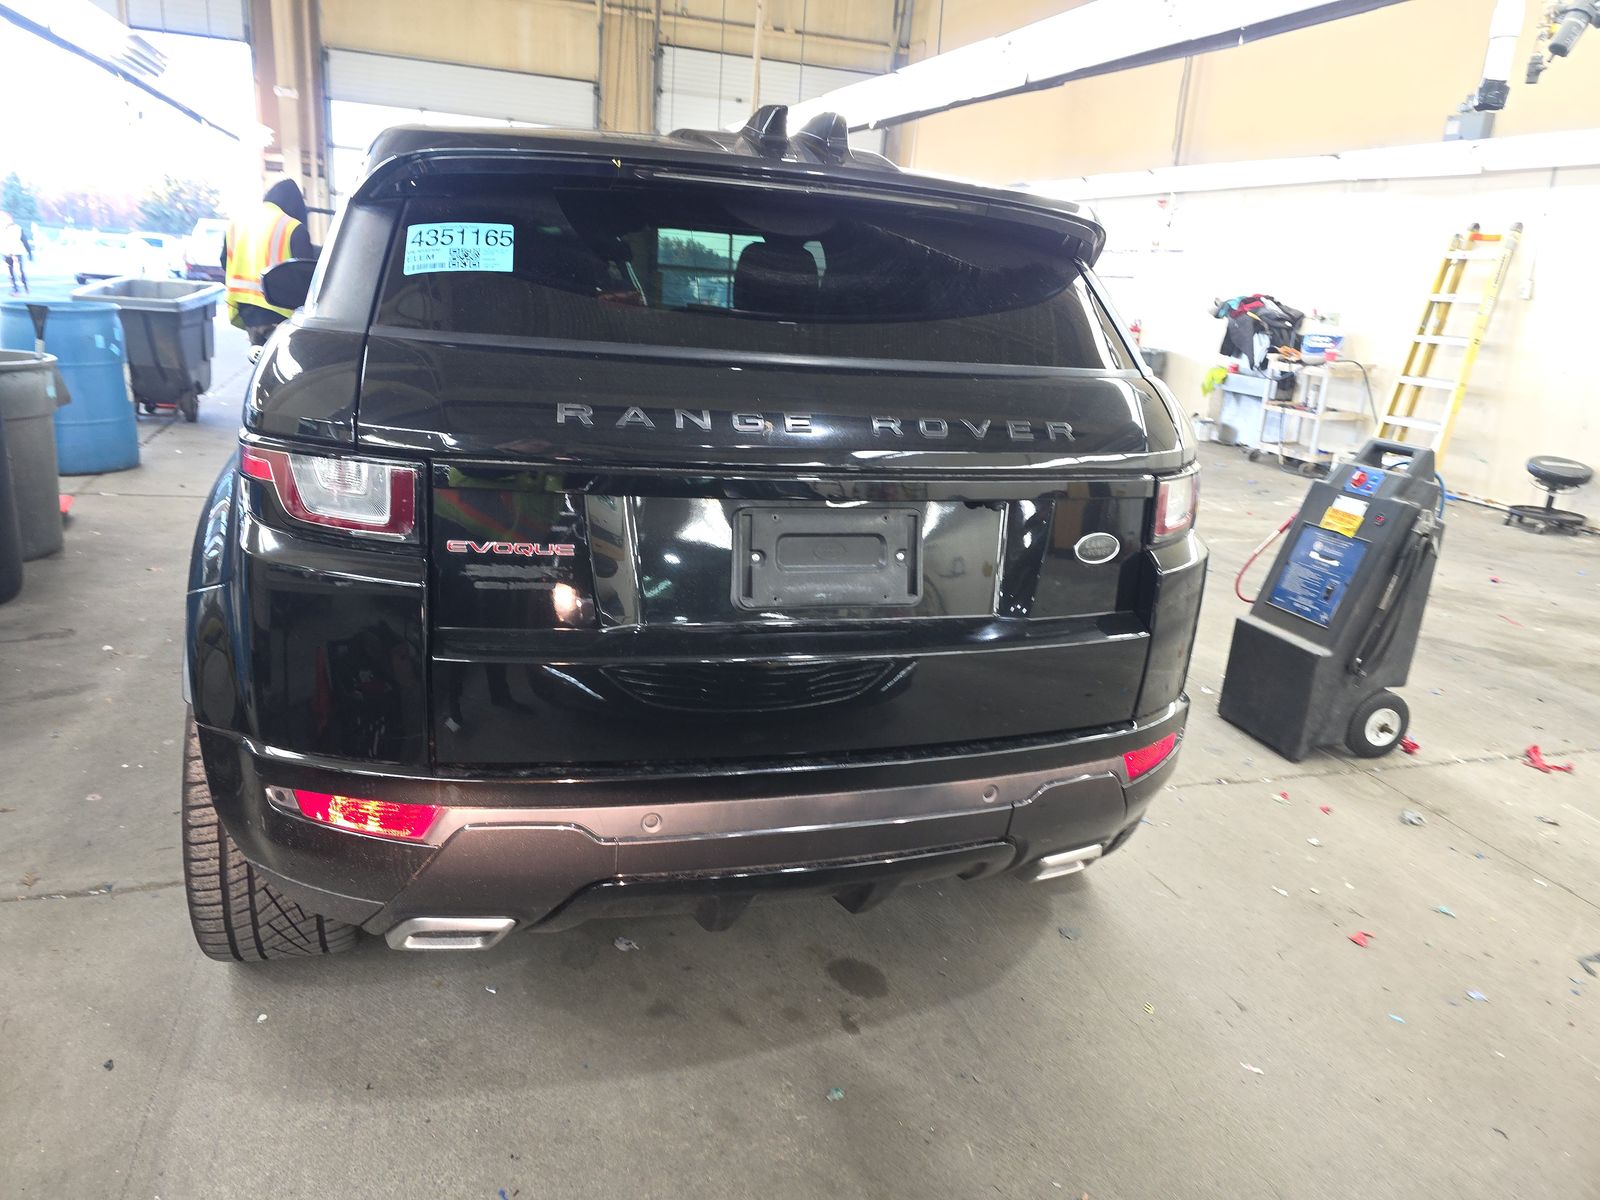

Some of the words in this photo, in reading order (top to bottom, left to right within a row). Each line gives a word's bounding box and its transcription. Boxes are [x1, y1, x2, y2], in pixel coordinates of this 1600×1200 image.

[411, 228, 514, 247] 4351165
[556, 402, 813, 434] RANGE
[870, 415, 1076, 442] ROVER
[446, 539, 576, 557] EVOQUE
